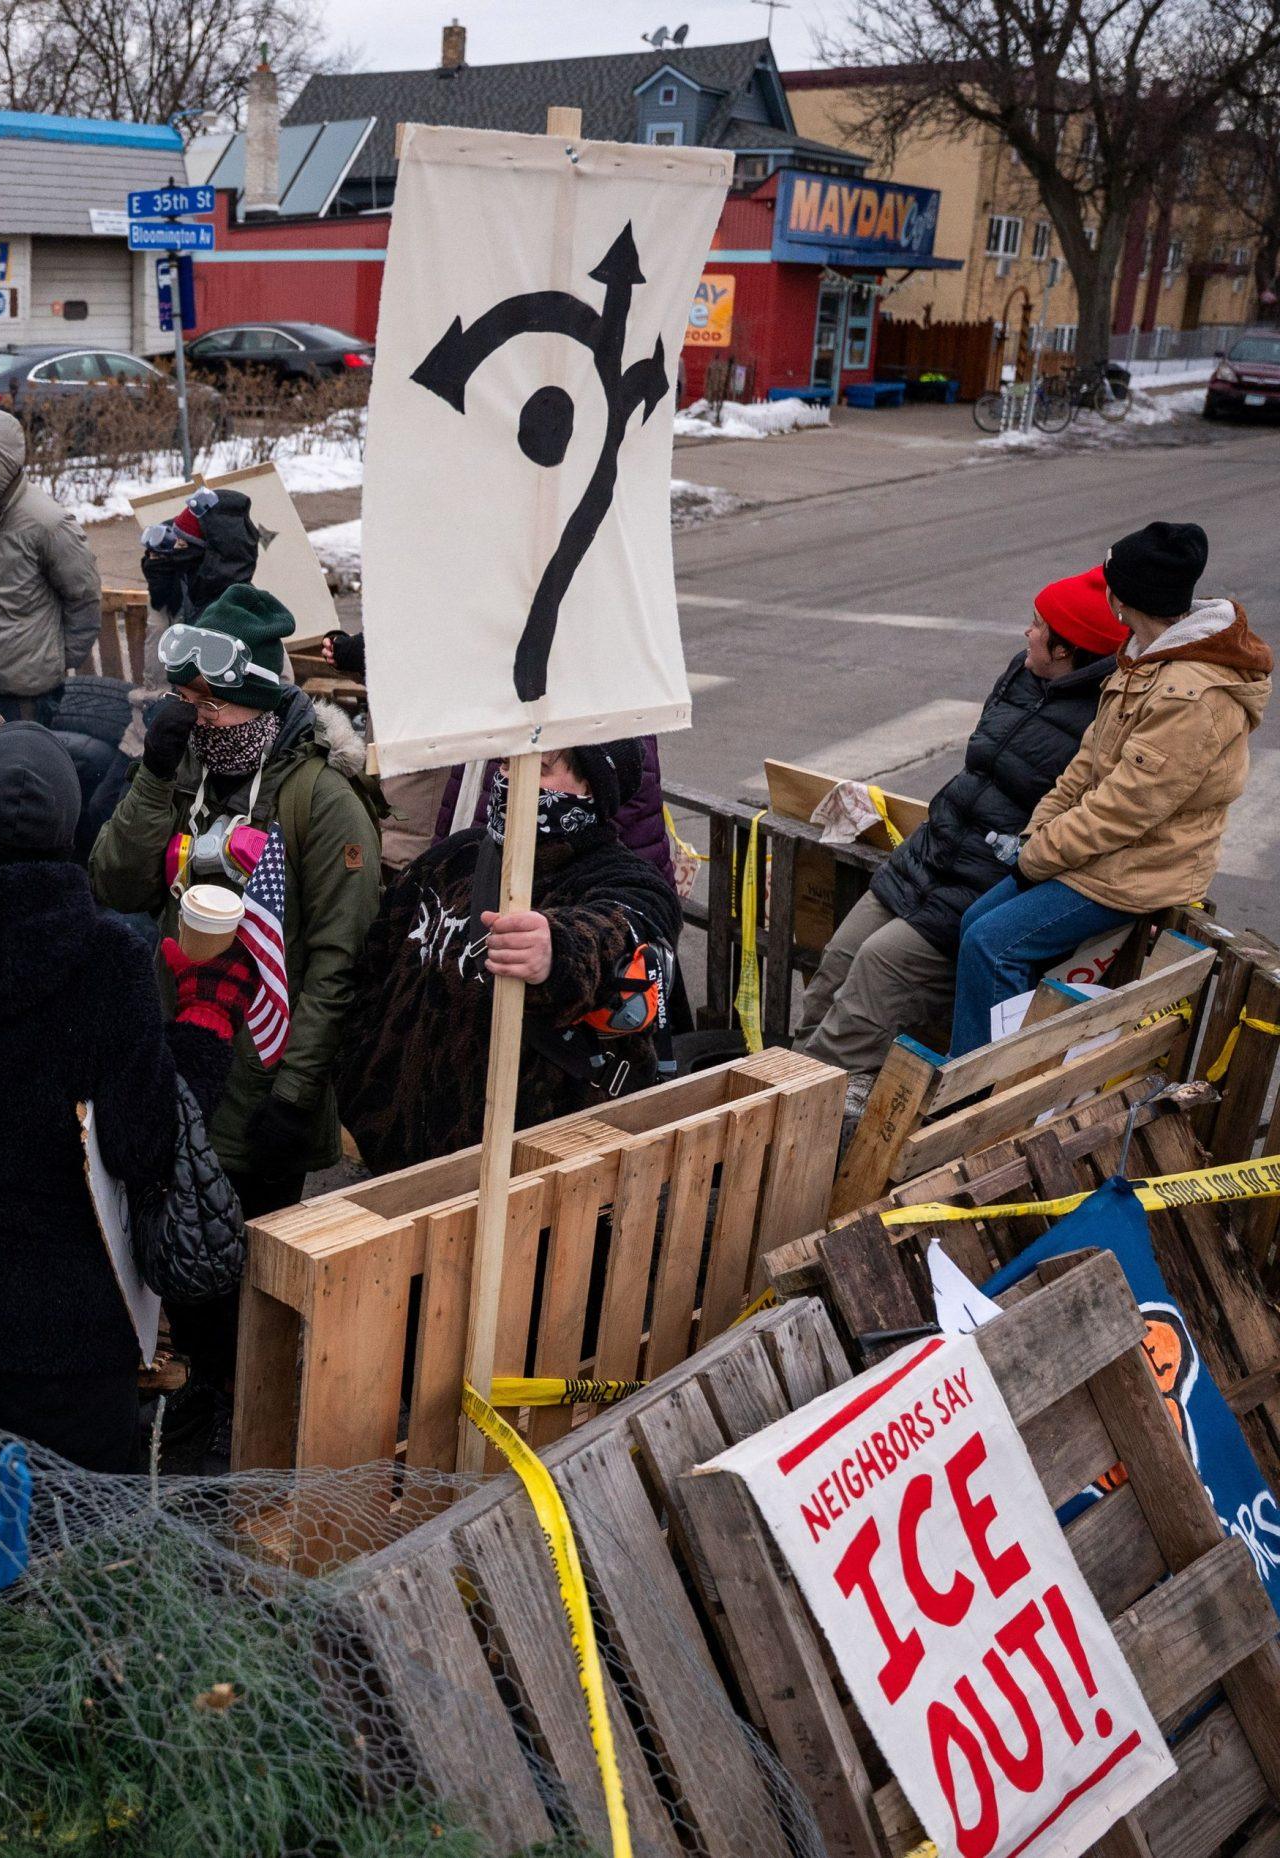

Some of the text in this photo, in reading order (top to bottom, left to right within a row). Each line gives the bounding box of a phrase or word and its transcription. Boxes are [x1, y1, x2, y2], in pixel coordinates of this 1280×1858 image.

[132, 191, 212, 214] E 35th St
[789, 179, 914, 241] MAYDAY
[131, 225, 211, 249] Bloomington Av
[1153, 1178, 1213, 1208] CROSS
[1205, 1172, 1247, 1200] NOT
[1237, 1167, 1271, 1195] DO
[799, 1367, 975, 1544] NEIGHBORS SAY
[832, 1431, 1032, 1706] ICE
[925, 1584, 1115, 1858] OUT!
